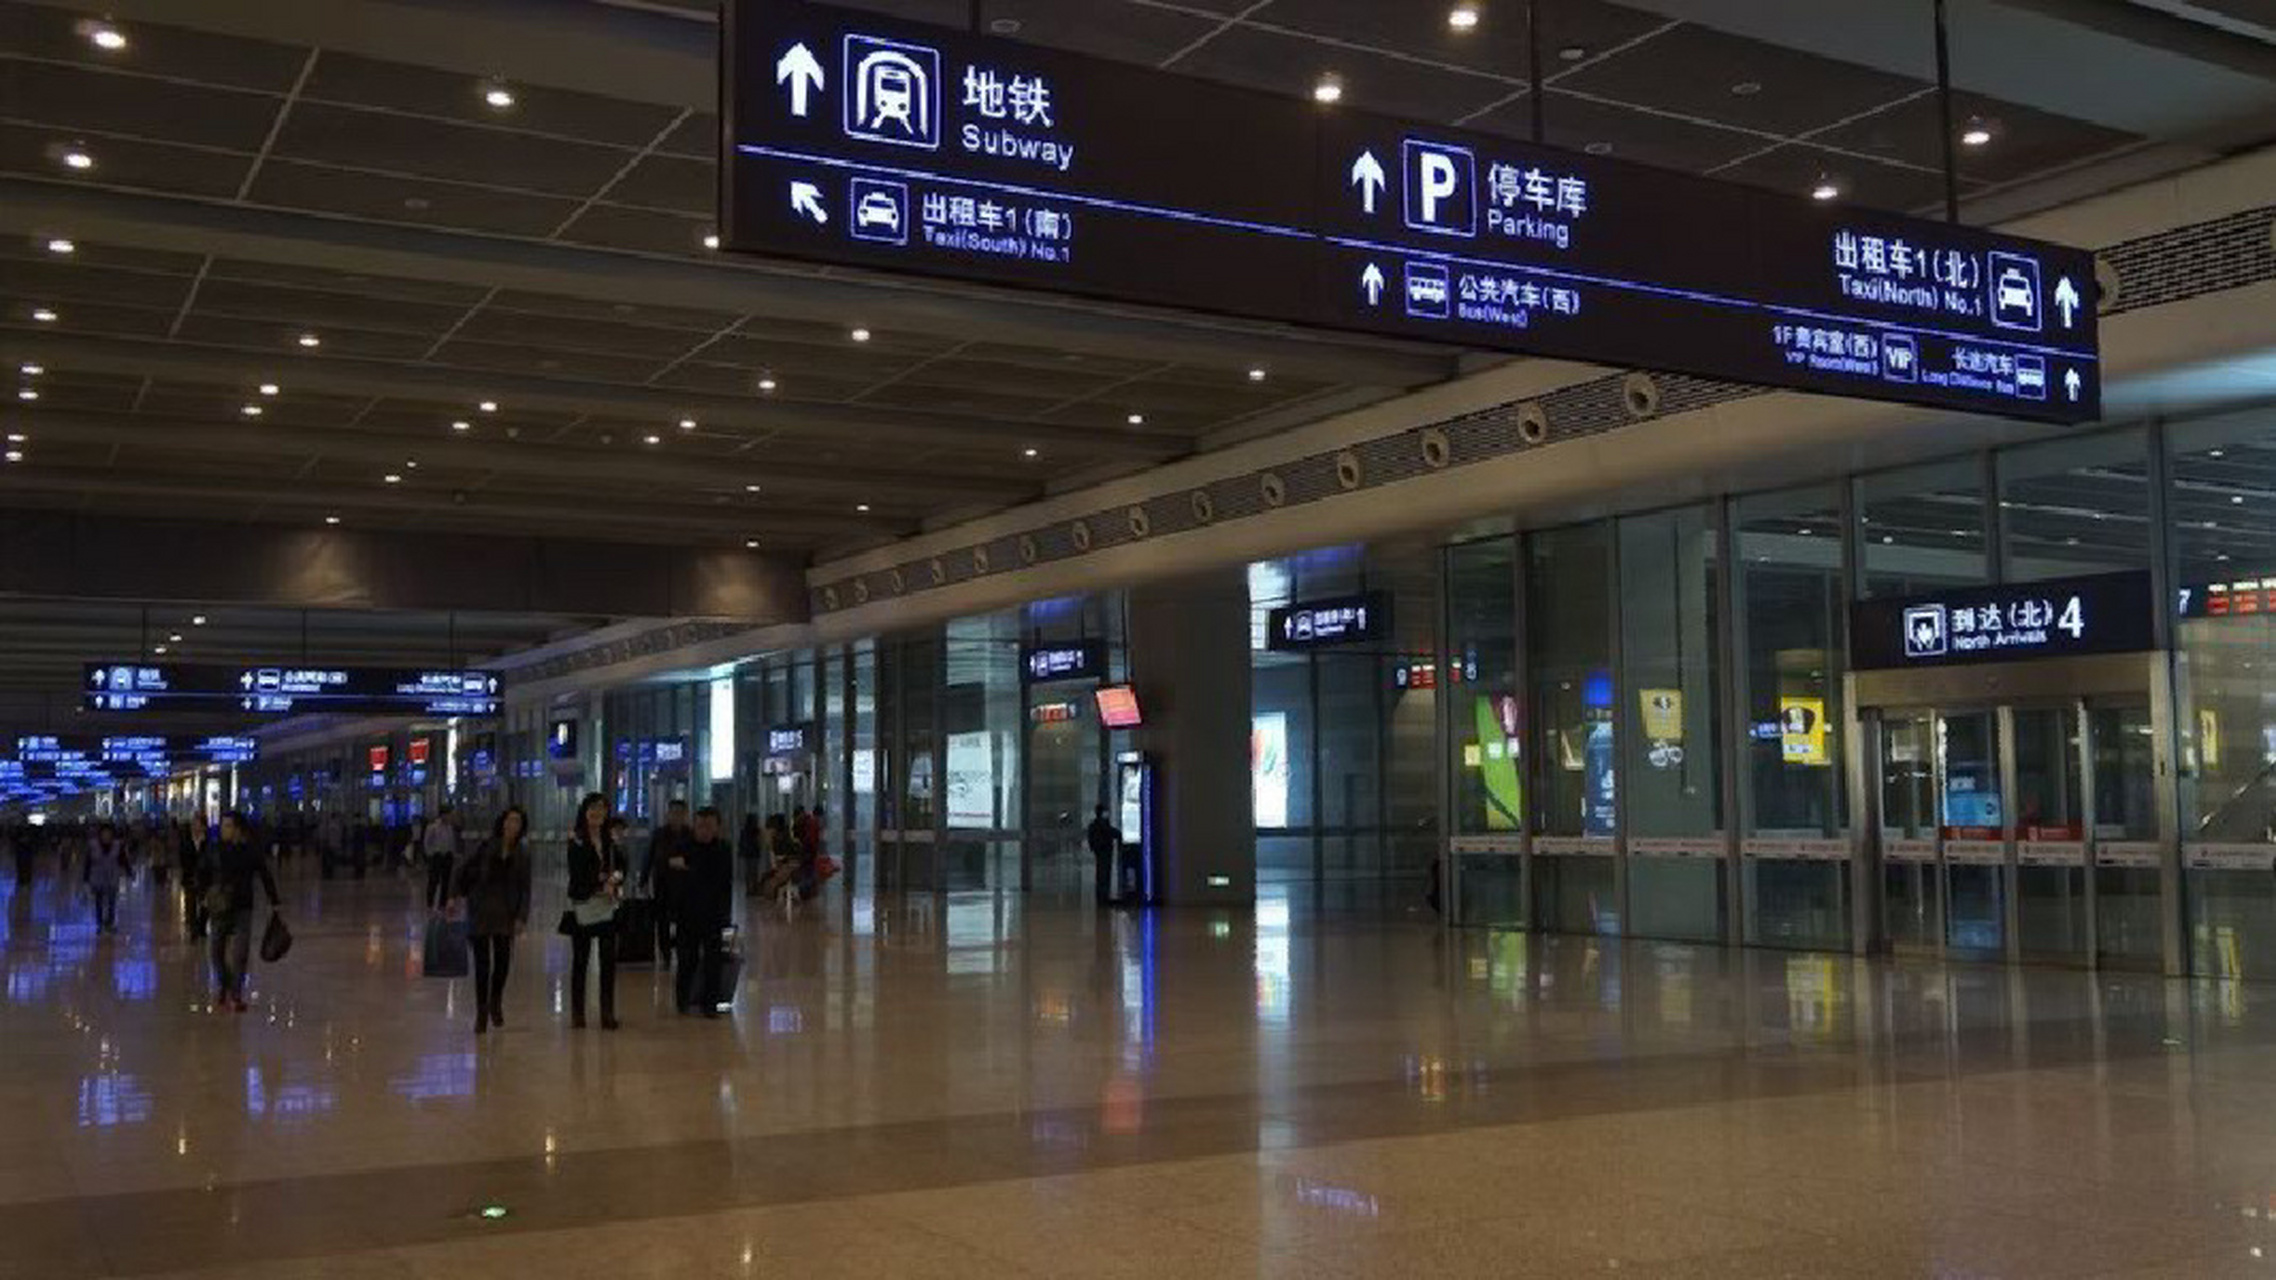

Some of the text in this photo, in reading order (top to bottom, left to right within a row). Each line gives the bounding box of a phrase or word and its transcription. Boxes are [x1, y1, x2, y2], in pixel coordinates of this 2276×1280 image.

[963, 65, 1053, 127] 地铁
[962, 123, 1074, 171] Subway
[1421, 151, 1456, 223] P
[1488, 163, 1588, 219] 停车库
[923, 225, 1027, 256] Taxi(South)
[1487, 208, 1569, 249] Parking
[1834, 231, 1979, 289] 出租车1(北)
[1458, 273, 1582, 315] 公共汽车(西)
[1838, 273, 1939, 310] Taxi(North)
[1886, 346, 1912, 370] VIP
[1952, 596, 2084, 639] 到达(北) 4
[1954, 635, 1990, 651] North
